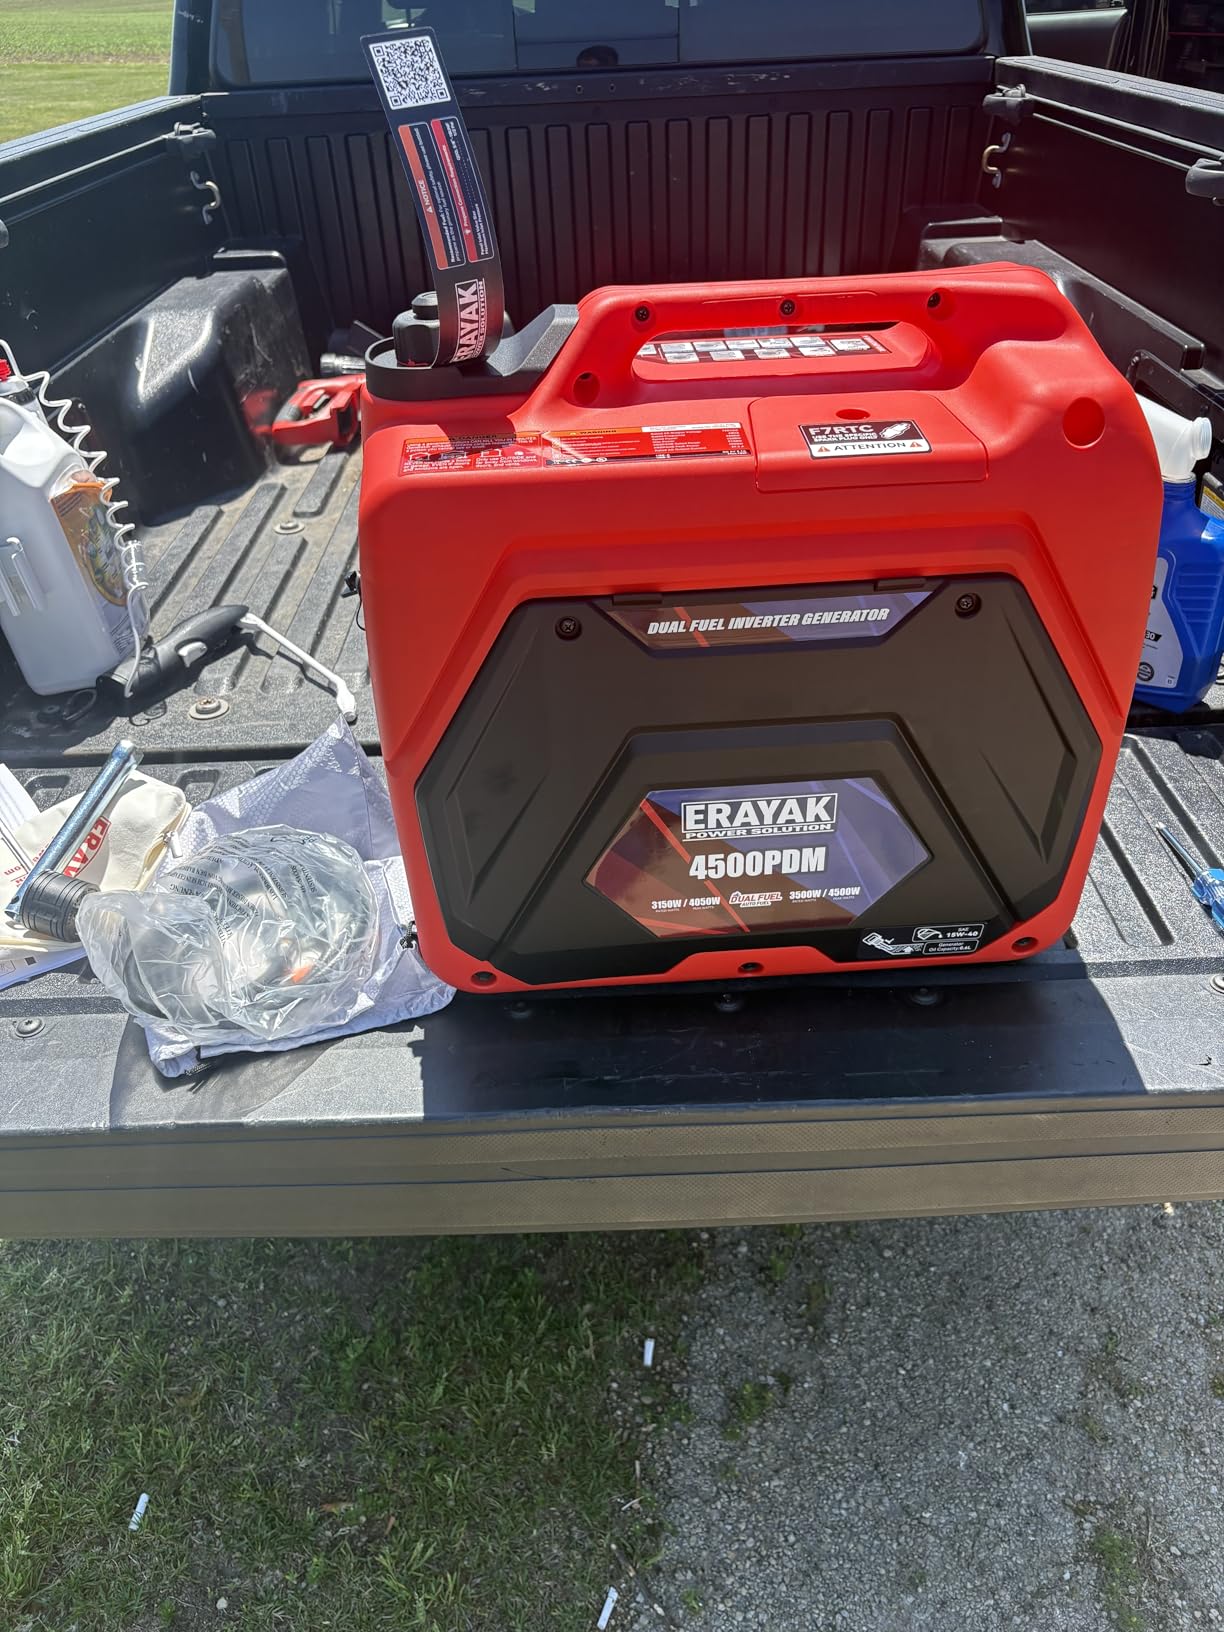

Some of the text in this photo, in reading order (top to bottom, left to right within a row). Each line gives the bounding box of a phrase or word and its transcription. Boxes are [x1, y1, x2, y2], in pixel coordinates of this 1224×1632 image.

[418, 178, 430, 206] NOTICE
[479, 281, 487, 331] SOLUTION
[455, 283, 478, 362] ERAYAK
[809, 425, 874, 435] F7RTC
[834, 442, 906, 451] ATTENTION
[647, 608, 890, 635] DUAL FUEL INVERTER GENERATOR
[1146, 632, 1156, 640] 30
[685, 796, 833, 830] ERAYAK
[685, 824, 832, 839] POWER SOLUTION
[689, 847, 826, 880] 4500PDM
[730, 891, 781, 903] DUAL FUEL
[789, 886, 861, 899] 3500W / 4500W
[651, 896, 721, 909] 3150W / 4050W
